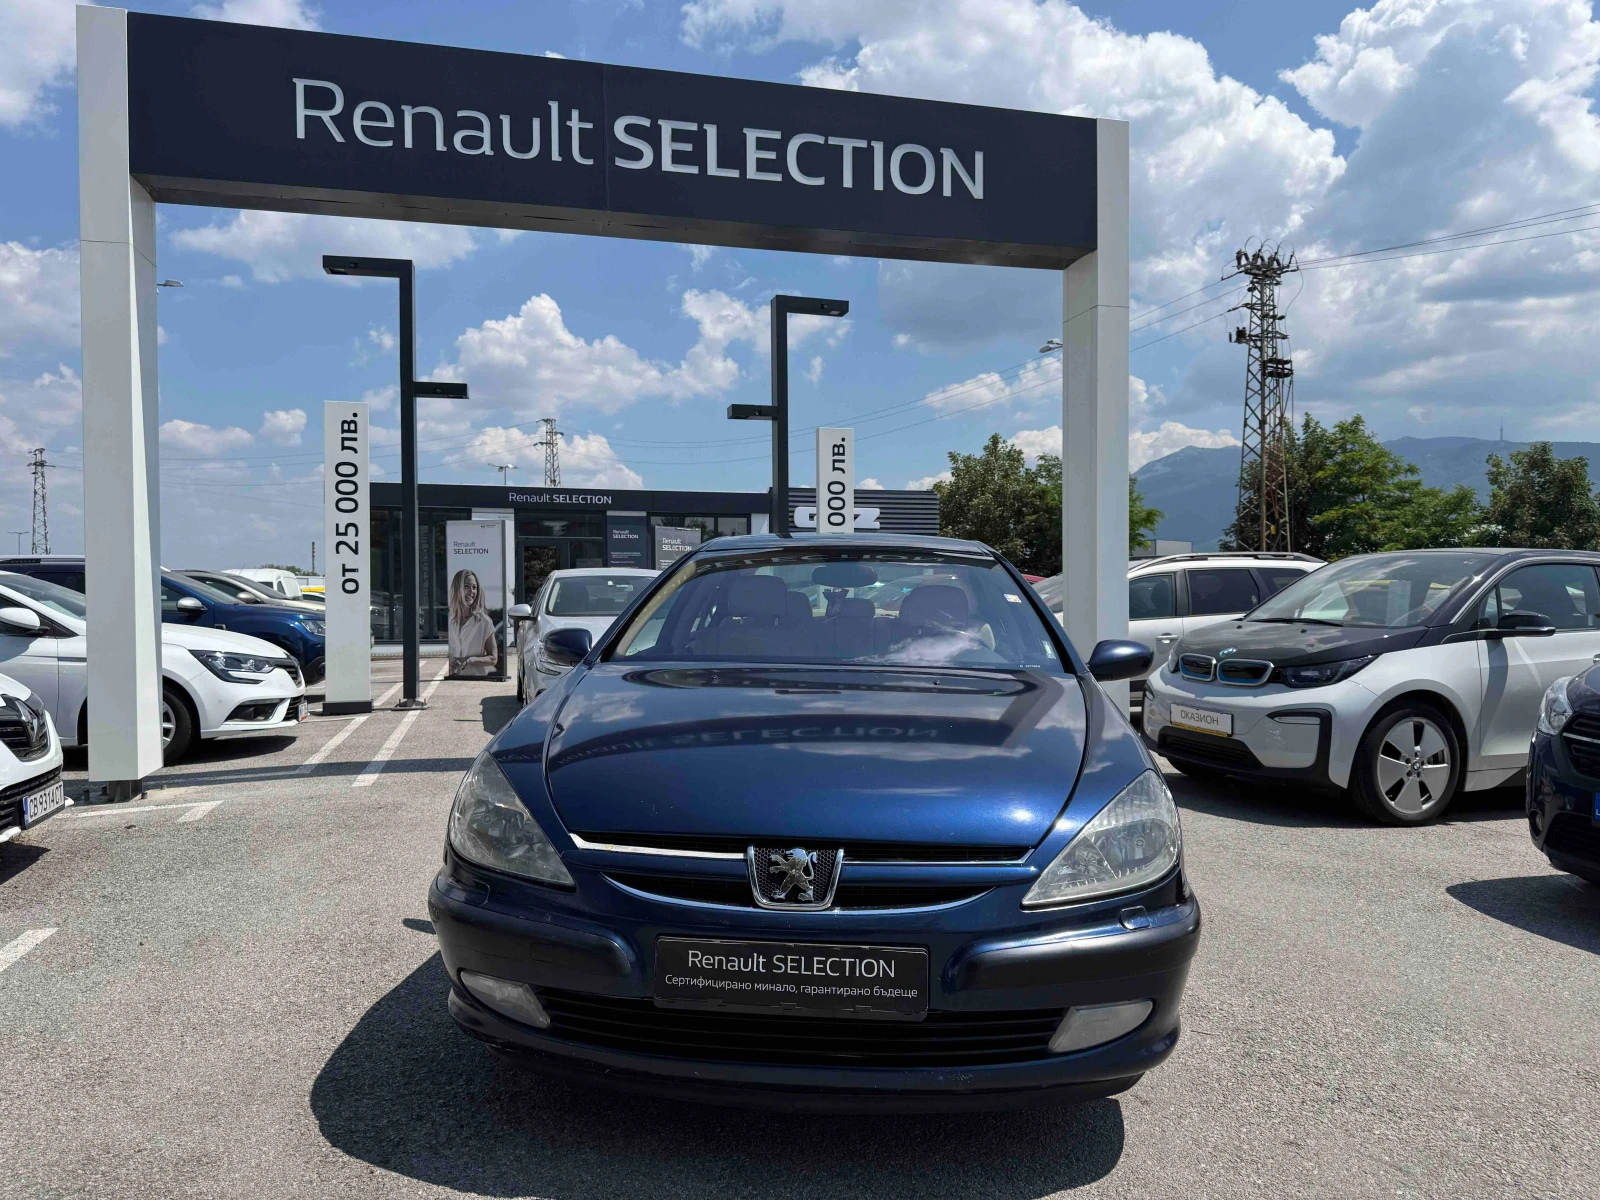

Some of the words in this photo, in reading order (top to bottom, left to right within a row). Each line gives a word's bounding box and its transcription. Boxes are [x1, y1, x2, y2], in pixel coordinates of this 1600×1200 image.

[293, 77, 594, 165] Renault
[614, 116, 984, 200] SELECTION
[335, 461, 358, 513] 000
[509, 492, 551, 503] Renault
[552, 494, 611, 505] SELECTION
[828, 480, 846, 527] 000
[336, 522, 359, 555] 25
[1180, 709, 1219, 725] ОКАЗИОН
[688, 950, 767, 973] Renault
[772, 954, 896, 978] SELECTION
[665, 974, 752, 992] Сертифицирано
[754, 983, 798, 994] минало,
[800, 985, 871, 998] гарантирано
[873, 986, 918, 998] бъдеще
